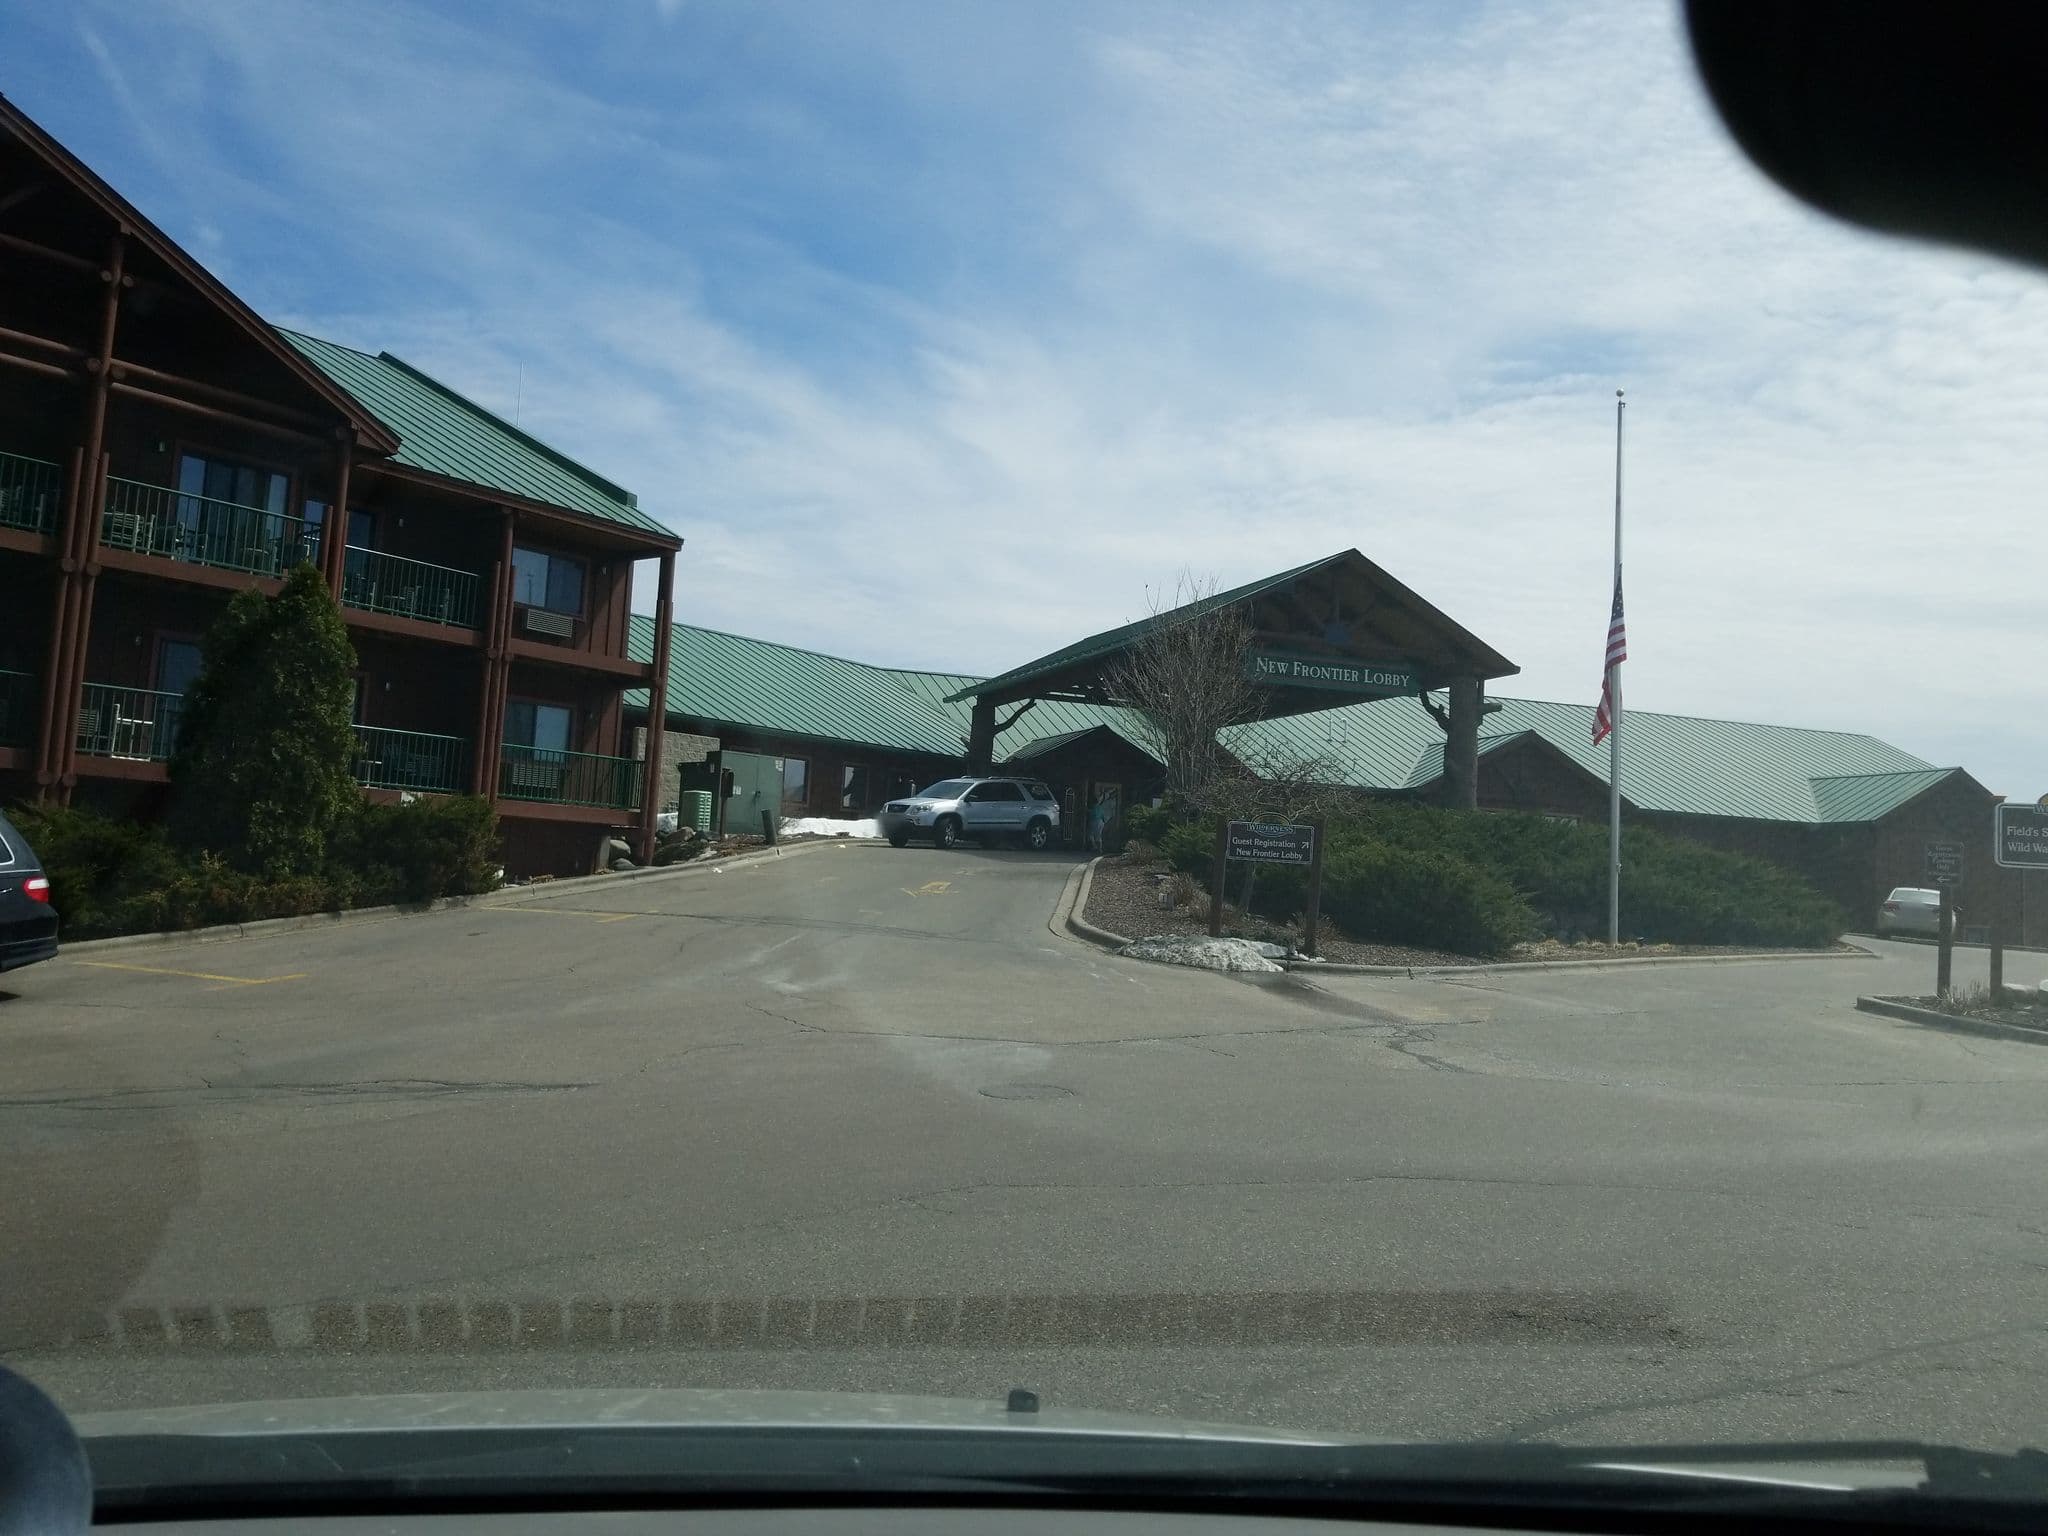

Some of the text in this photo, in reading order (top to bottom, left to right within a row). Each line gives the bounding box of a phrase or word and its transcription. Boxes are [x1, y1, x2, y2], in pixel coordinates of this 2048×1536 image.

[1256, 657, 1410, 687] NEW FRONTIER LOBBY
[2007, 826, 2039, 837] Field's
[1232, 837, 1296, 848] Guest Registration
[2007, 841, 2031, 852] Wild
[1236, 848, 1303, 861] New Frontier Lobby
